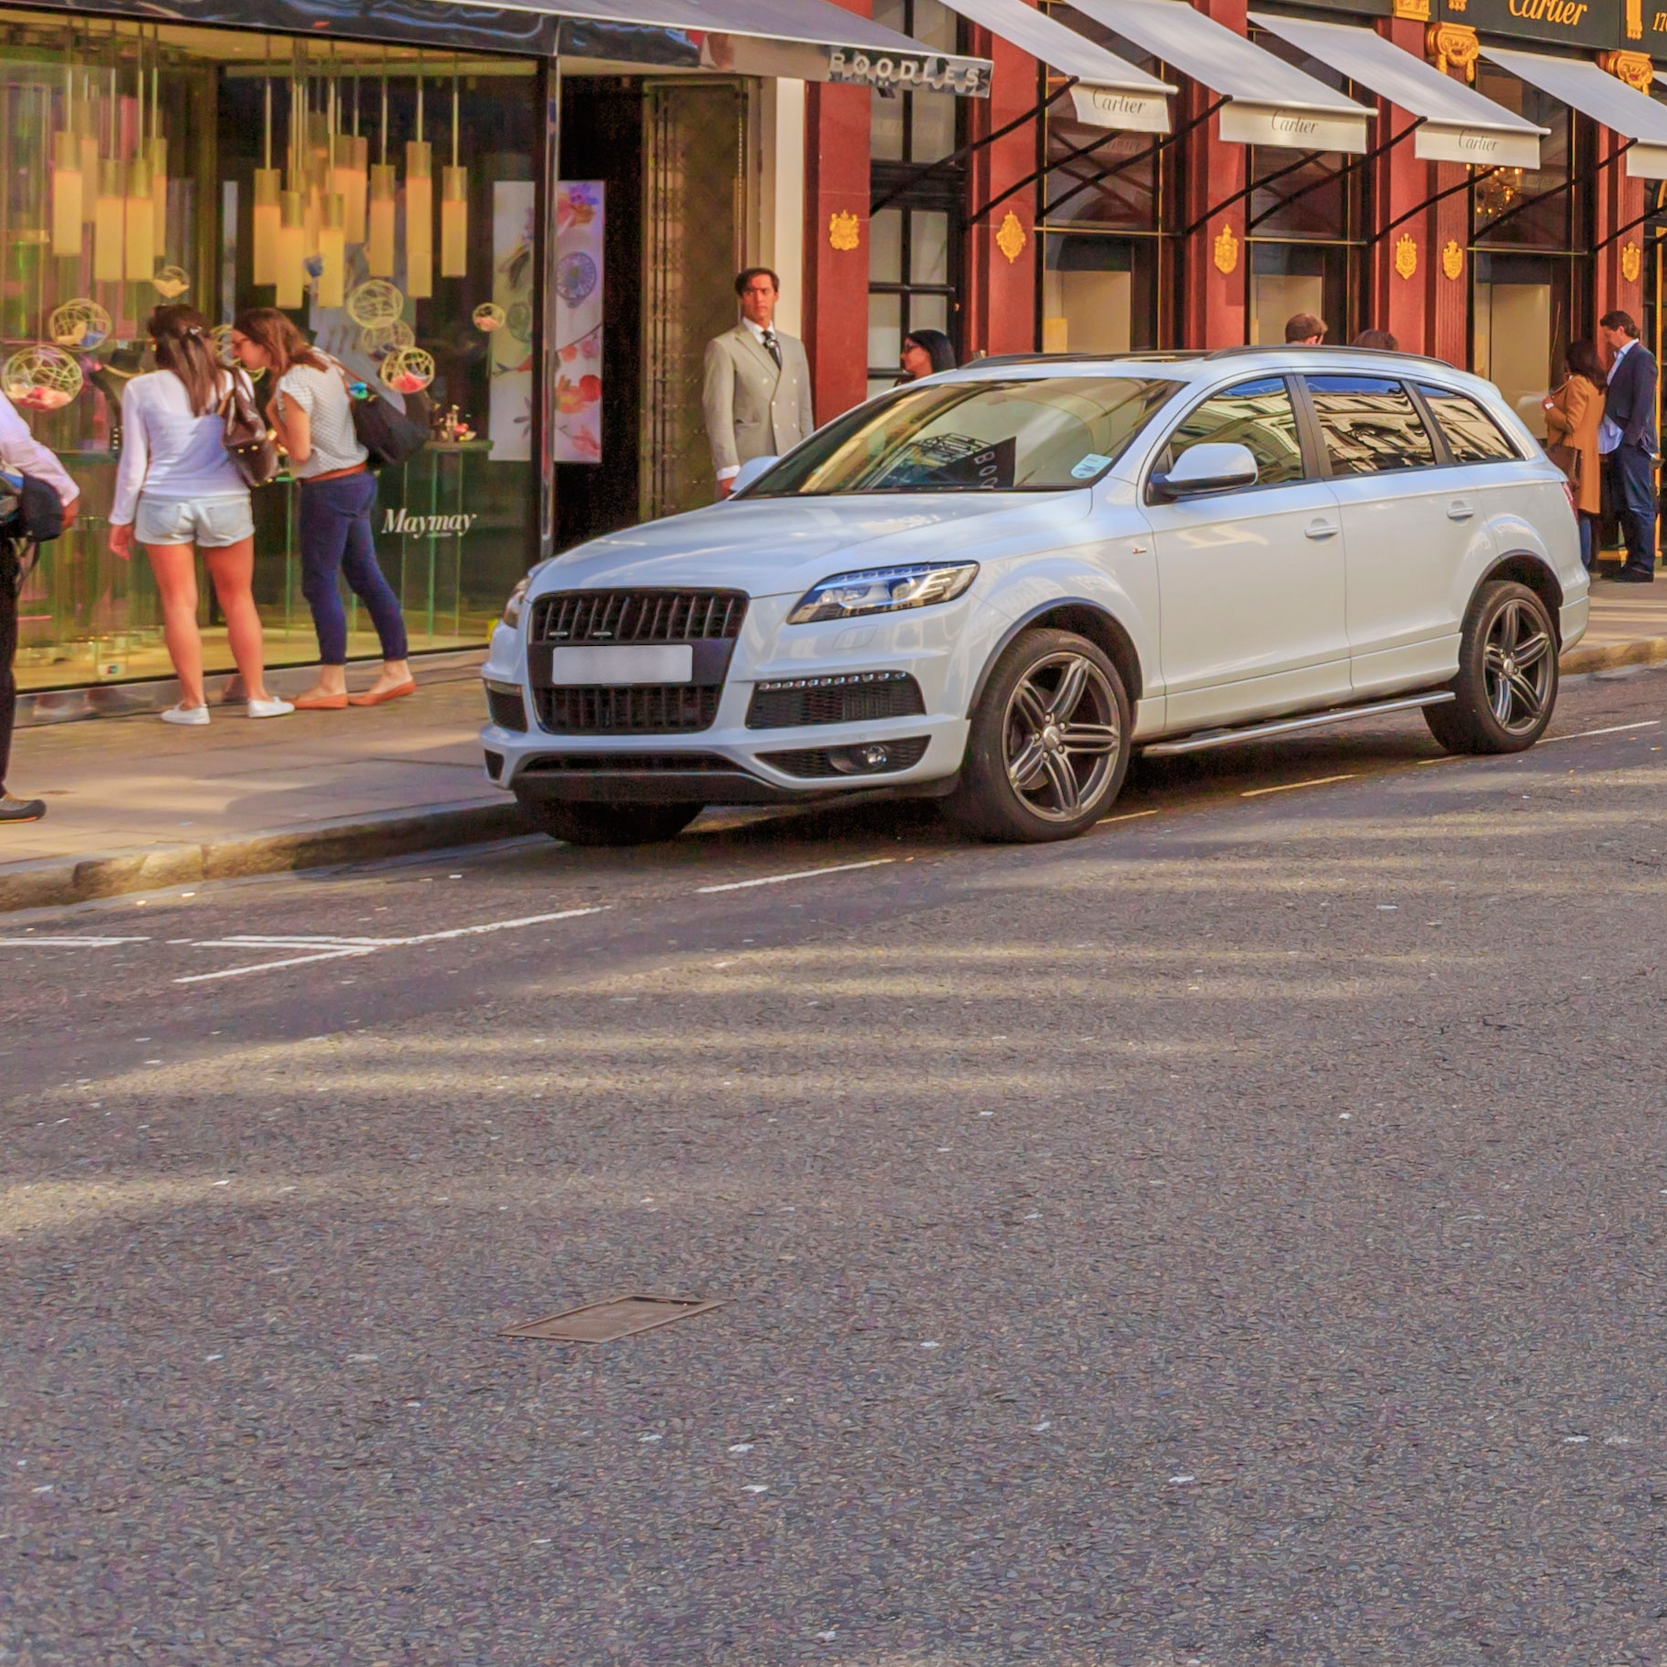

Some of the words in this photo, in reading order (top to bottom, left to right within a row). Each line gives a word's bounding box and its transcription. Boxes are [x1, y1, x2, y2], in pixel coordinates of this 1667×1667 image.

[829, 52, 979, 86] BOODLES
[1092, 86, 1147, 115] Cartier
[1271, 108, 1319, 136] Cartier
[1457, 126, 1499, 153] Cartier
[381, 508, 477, 539] Maymay
